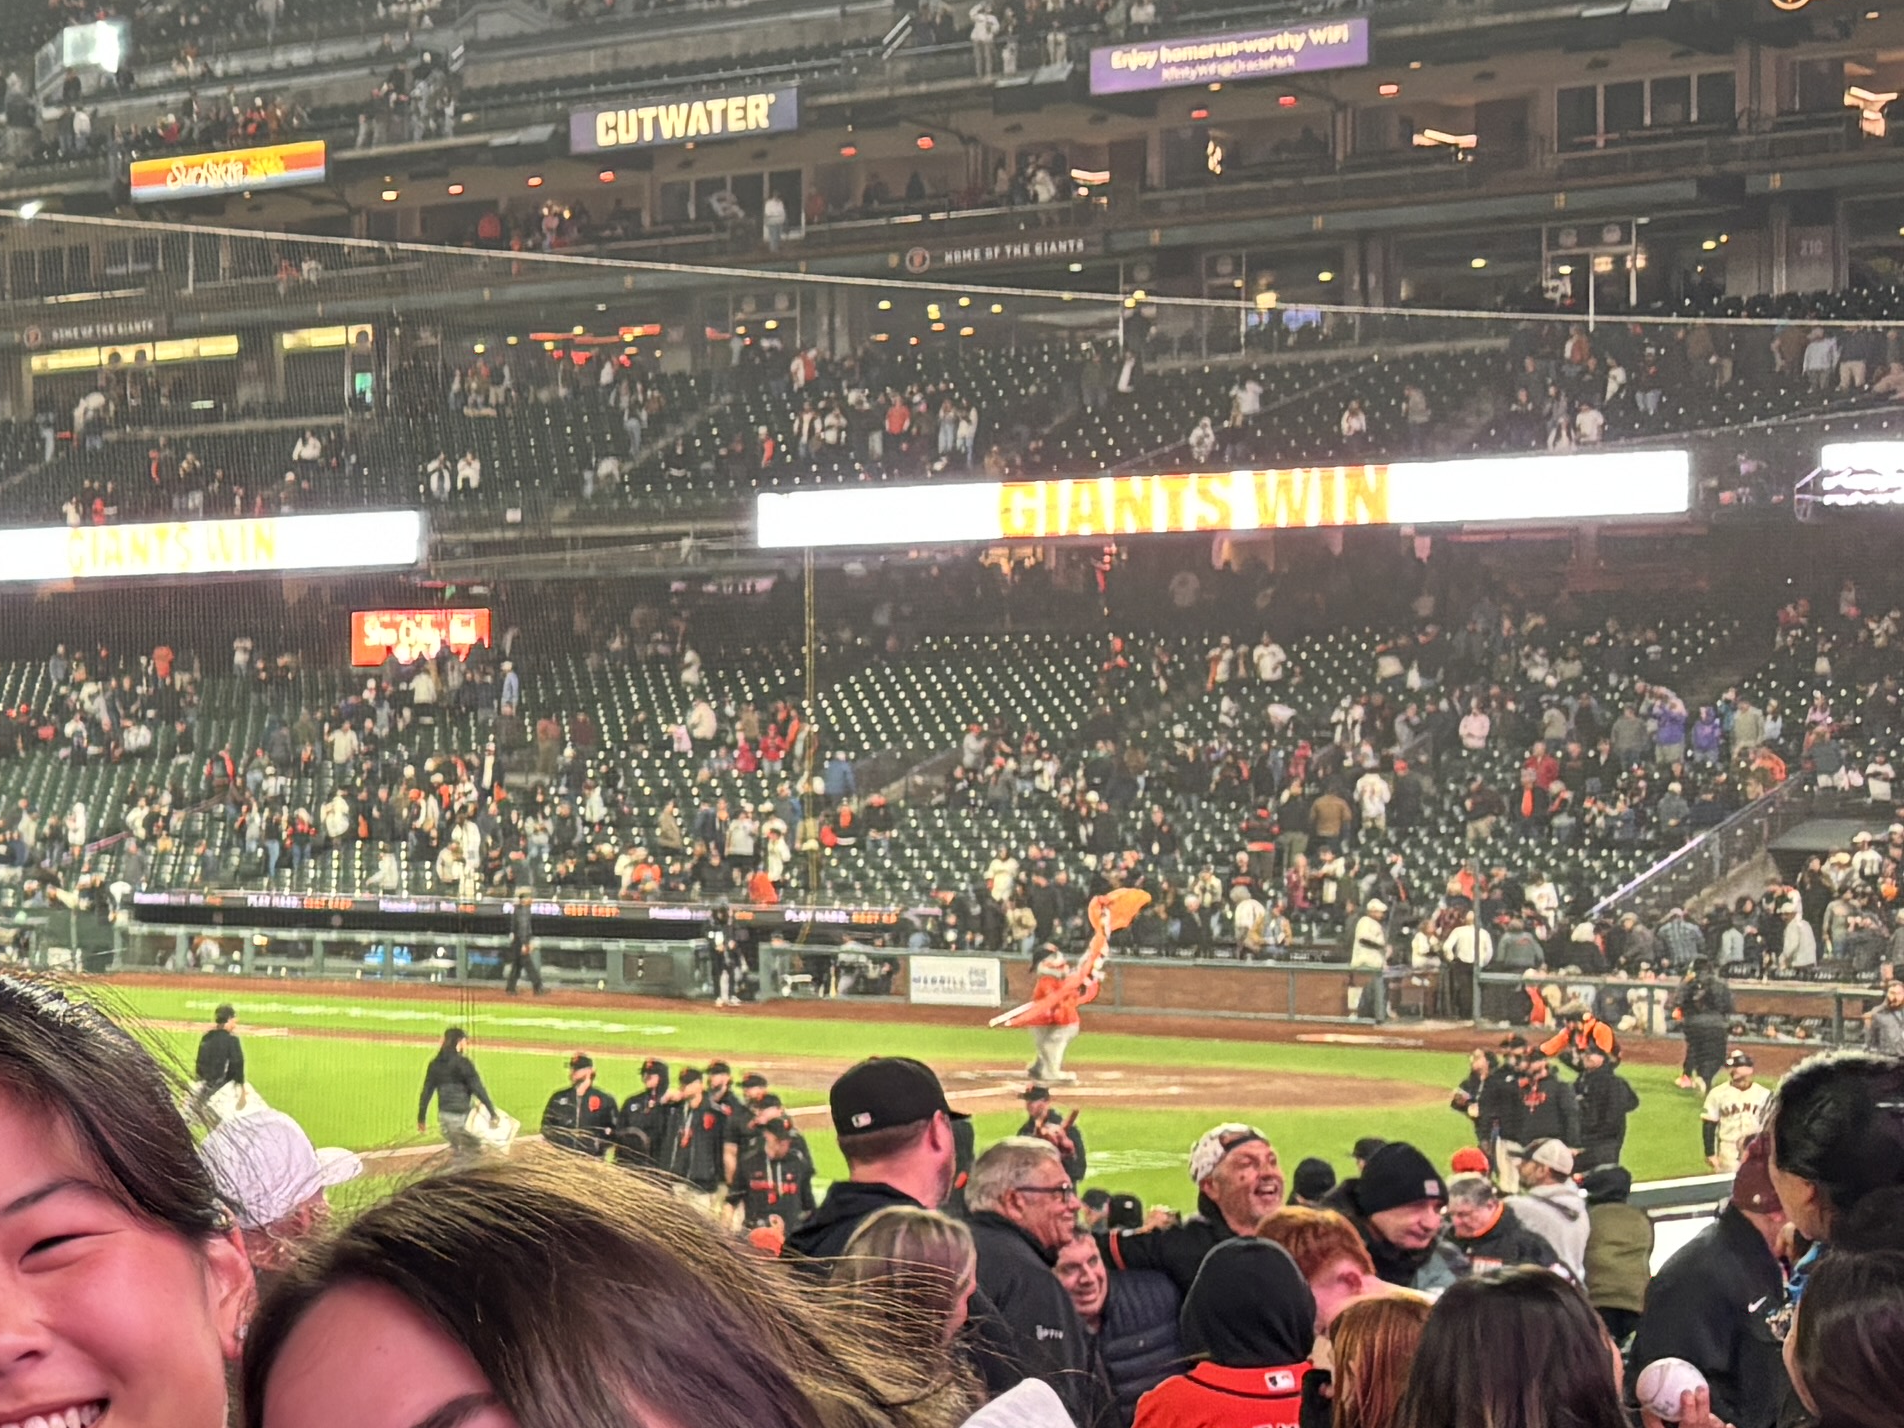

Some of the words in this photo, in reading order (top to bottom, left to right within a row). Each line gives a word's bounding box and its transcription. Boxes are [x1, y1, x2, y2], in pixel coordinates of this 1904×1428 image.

[596, 94, 771, 147] CUTWATER
[999, 473, 1234, 537] GIANTS
[1254, 464, 1390, 528] WIN
[67, 522, 191, 577] GIANTS
[207, 520, 275, 564] WIN
